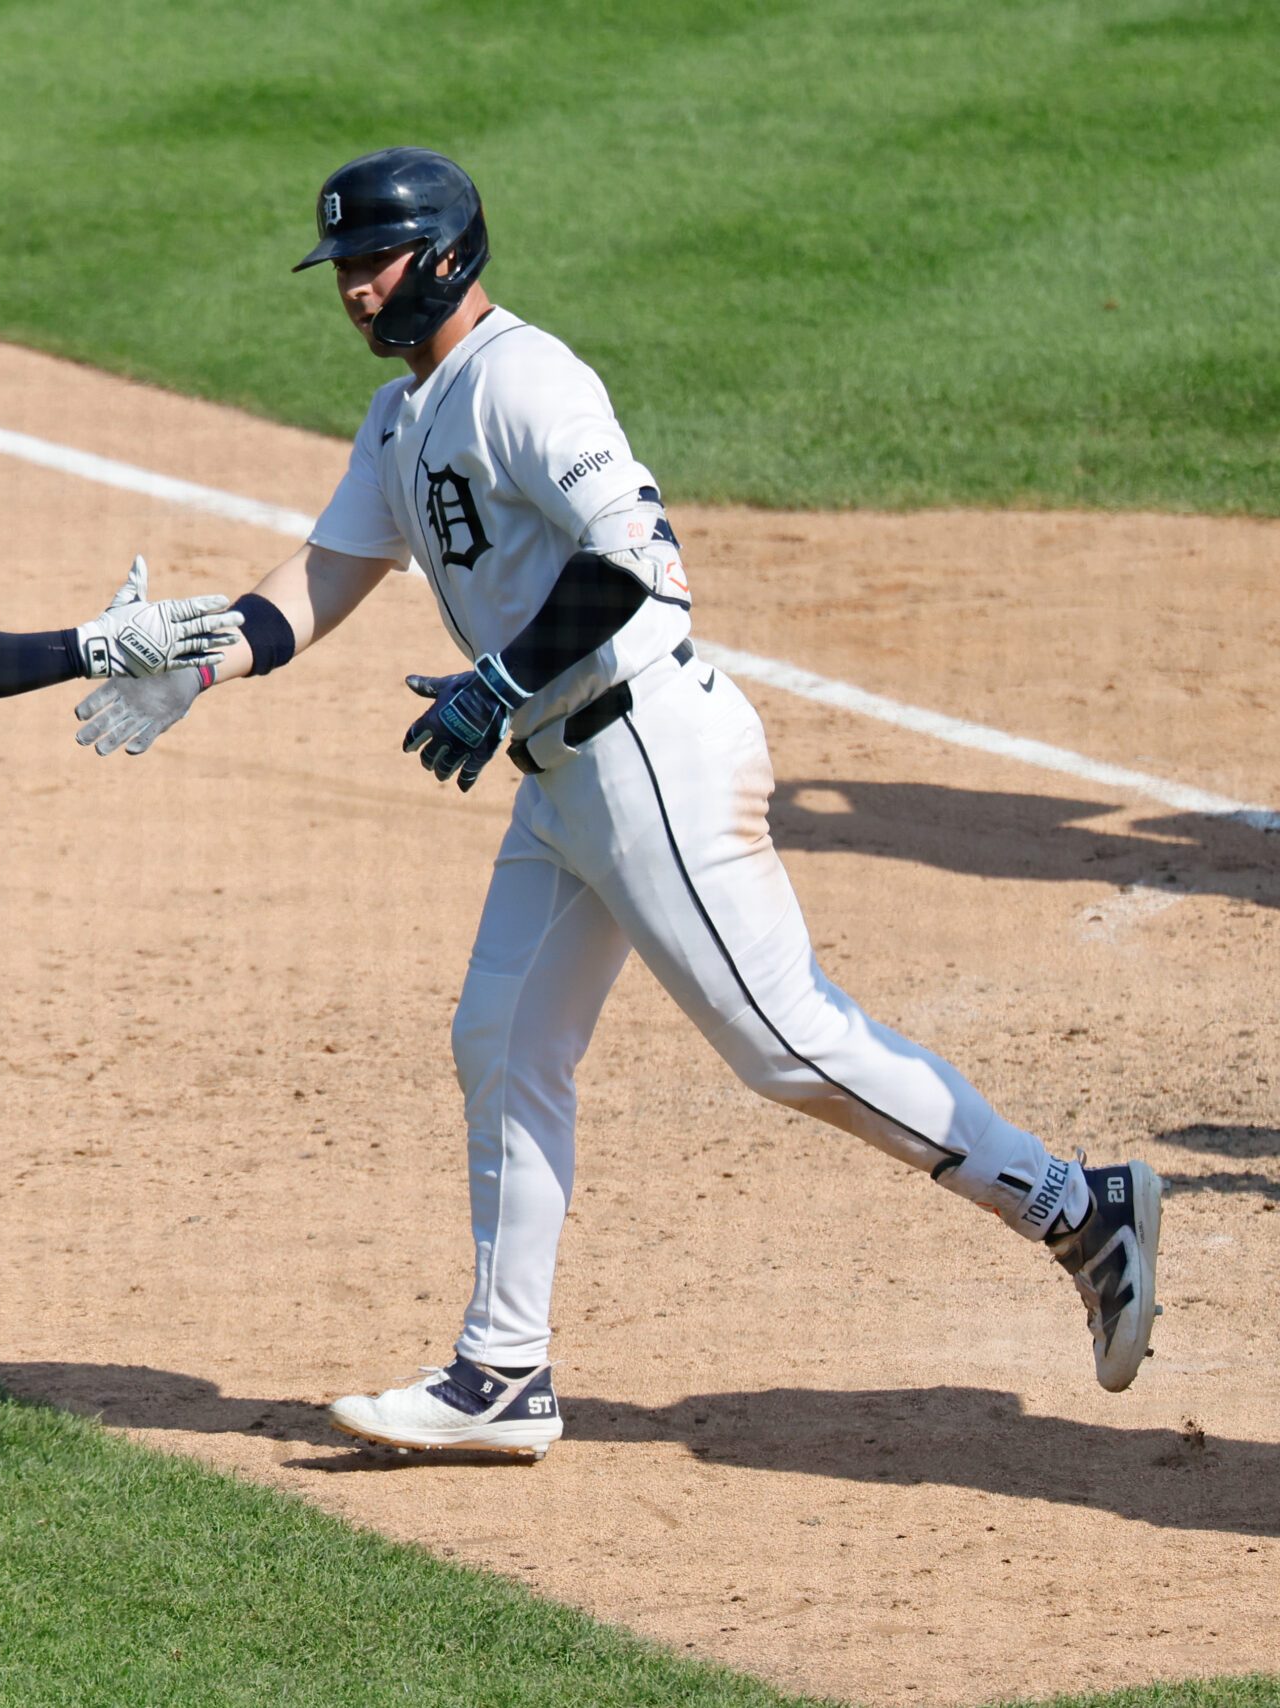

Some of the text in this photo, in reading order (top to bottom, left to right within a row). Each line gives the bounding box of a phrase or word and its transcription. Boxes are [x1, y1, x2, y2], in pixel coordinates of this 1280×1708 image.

[558, 449, 614, 492] meijer
[420, 458, 494, 571] D
[627, 523, 644, 538] 20
[1107, 1176, 1125, 1203] 20
[527, 1395, 552, 1415] ST
